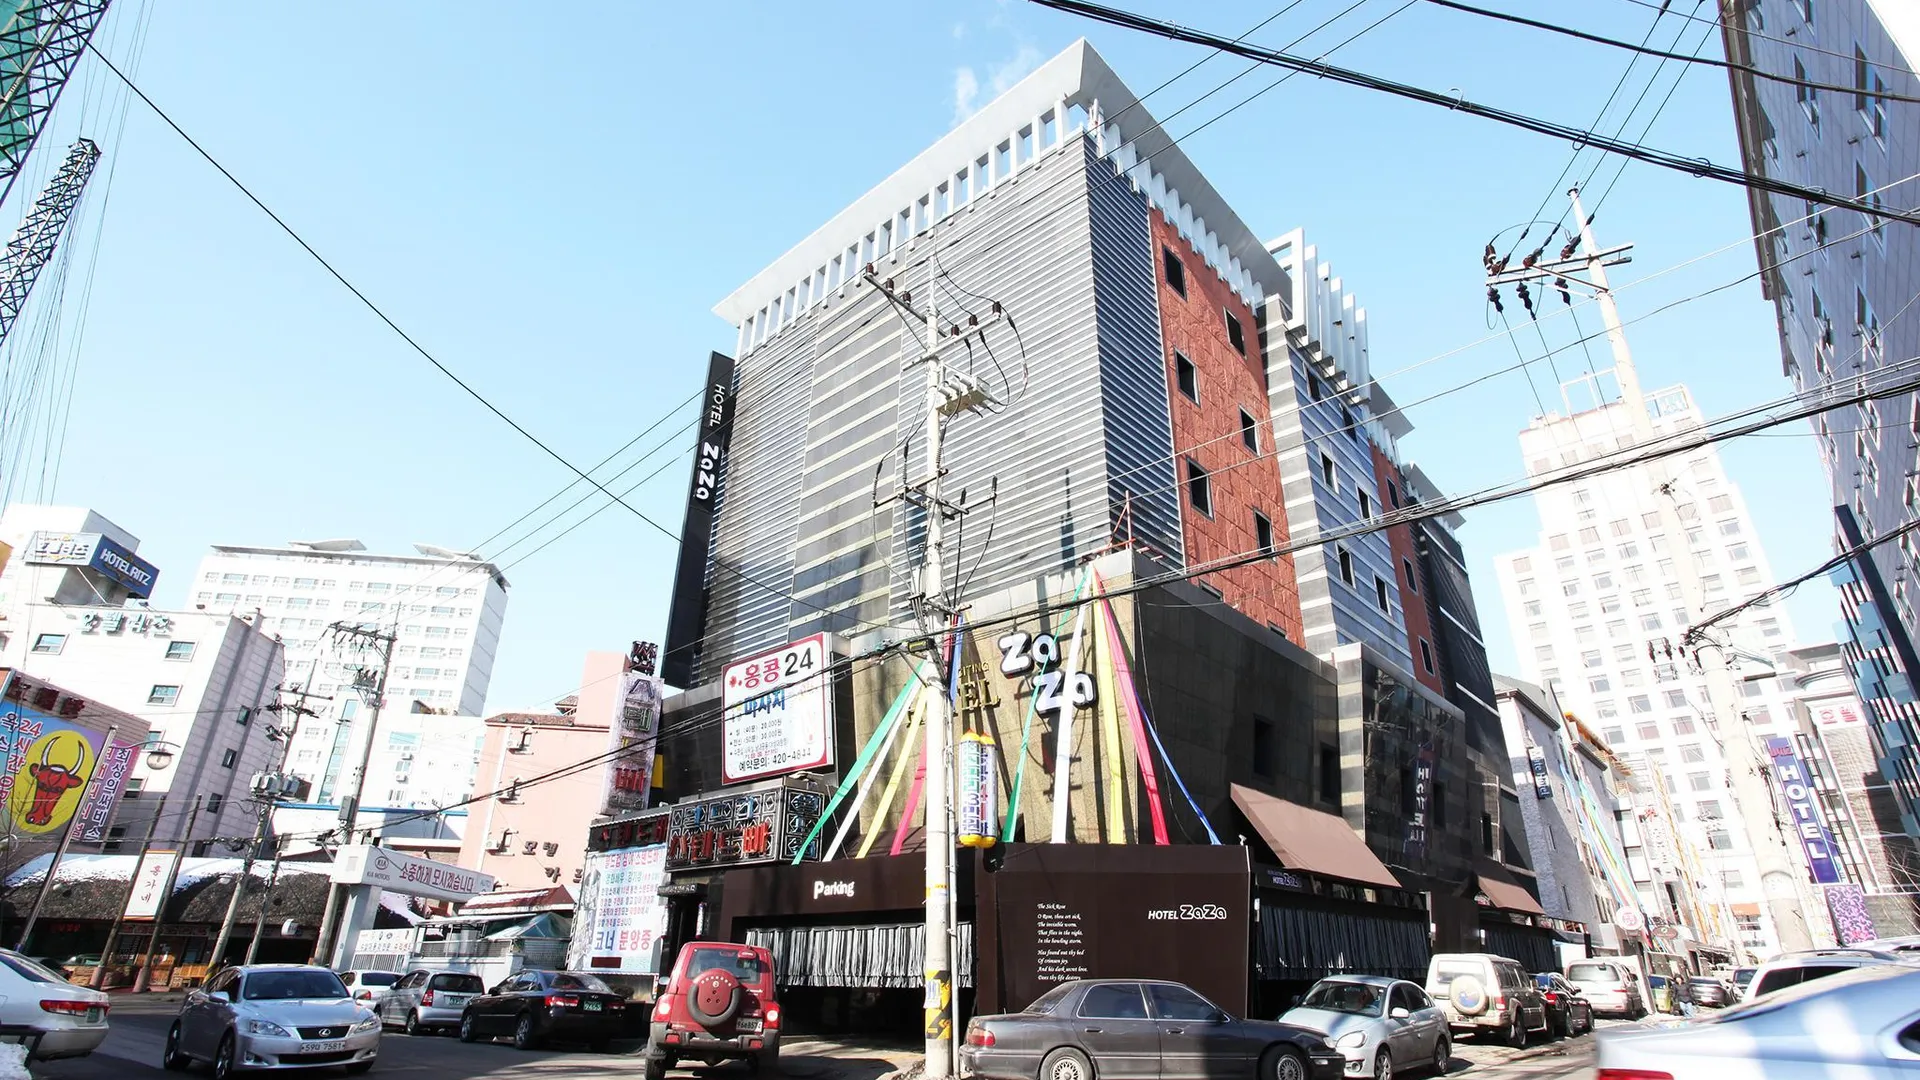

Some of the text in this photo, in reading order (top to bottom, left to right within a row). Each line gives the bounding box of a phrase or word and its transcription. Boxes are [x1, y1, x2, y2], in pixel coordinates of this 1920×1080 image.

[710, 383, 725, 427] HOTEL
[100, 548, 151, 586] HOTEL RITZ
[744, 647, 814, 689] 홍콩 24
[744, 689, 786, 718] 마사지
[738, 756, 770, 772] 예약문의:
[1779, 765, 1828, 860] HOTEL
[522, 840, 559, 857] 모텔
[399, 862, 475, 893] 소중하게 모시겠습니다
[813, 880, 855, 900] Parking
[1148, 904, 1227, 920] HOTEL ZaZa
[594, 929, 653, 951] 코너 분양중
